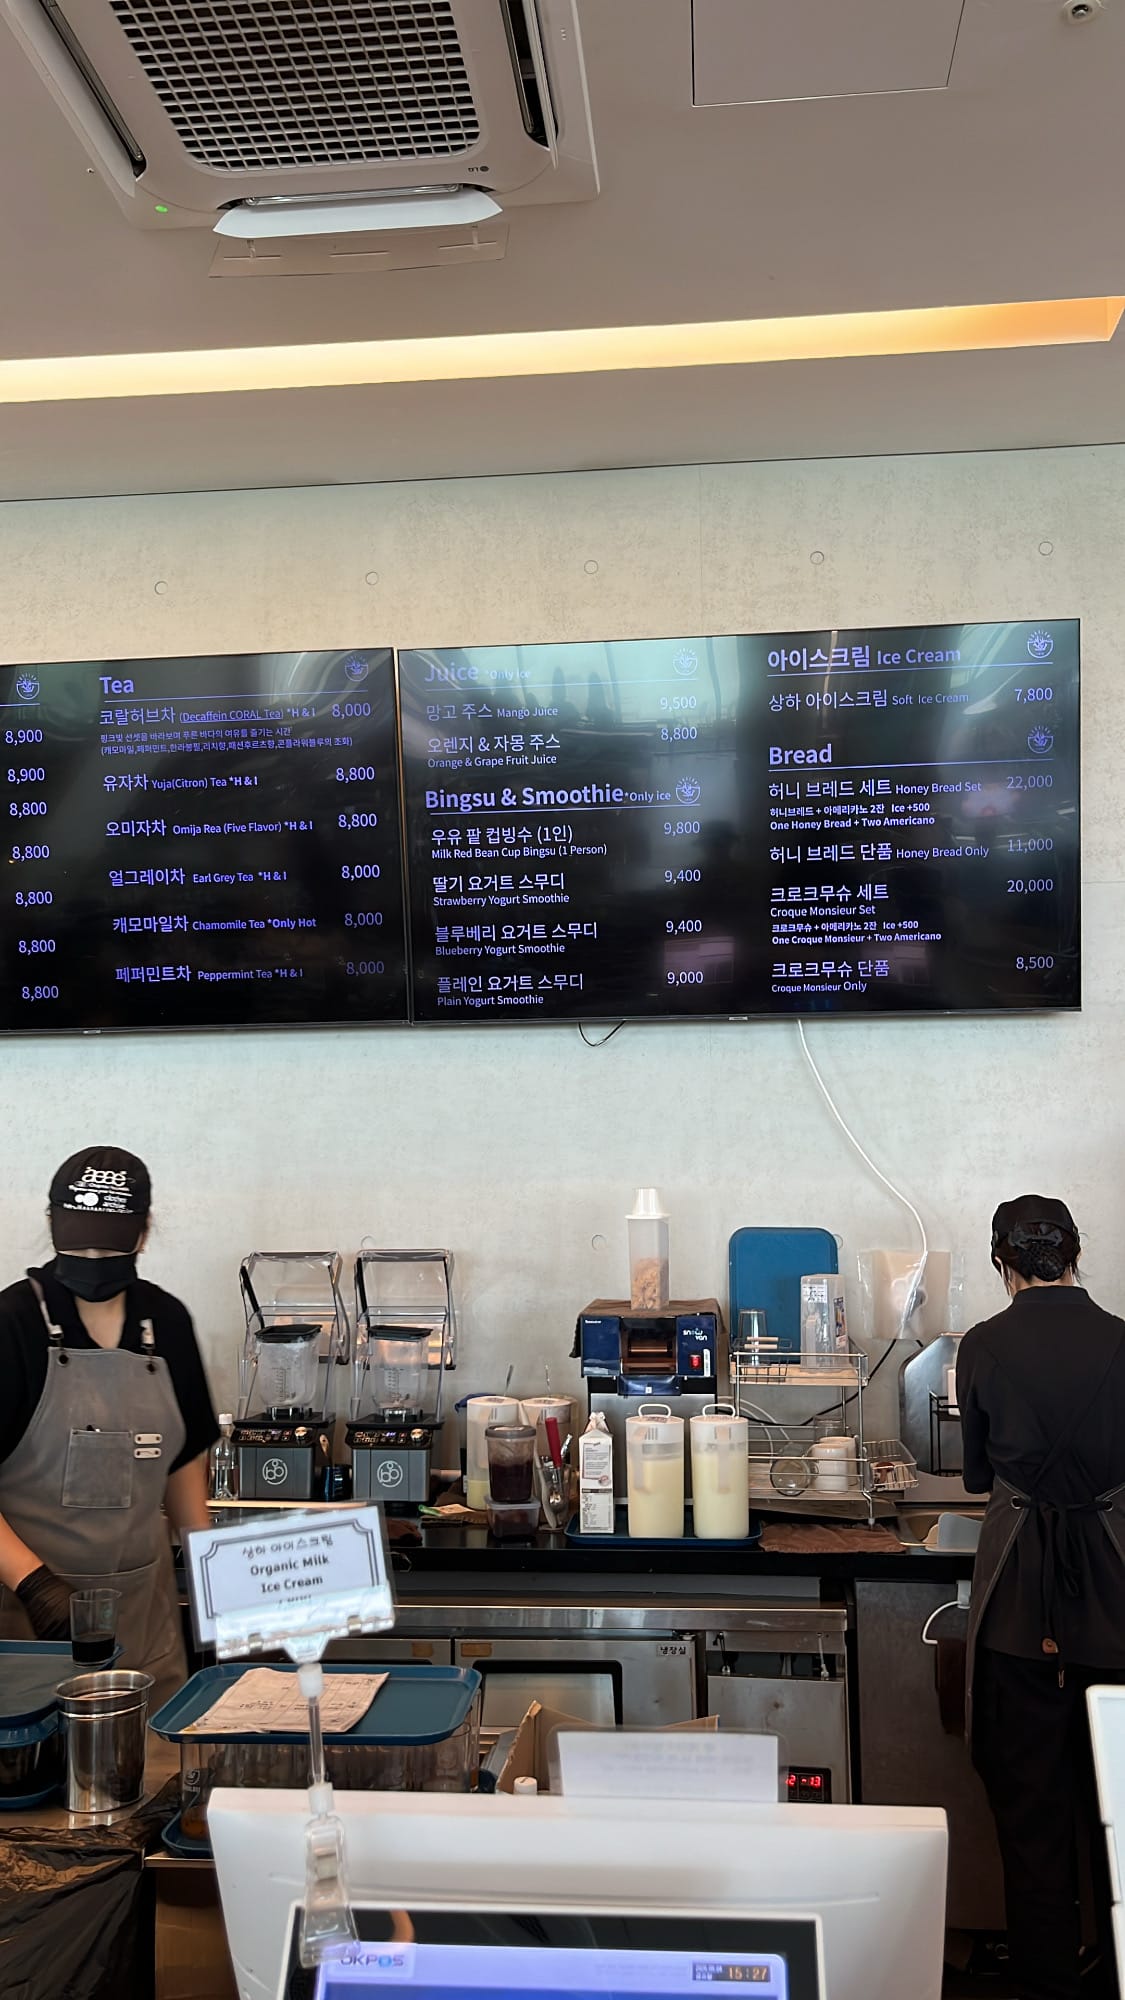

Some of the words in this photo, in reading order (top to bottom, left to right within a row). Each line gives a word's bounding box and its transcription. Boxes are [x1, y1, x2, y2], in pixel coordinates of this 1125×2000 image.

[768, 645, 870, 670] 아이스크림
[877, 650, 901, 665] Ice
[905, 649, 961, 664] Cream
[424, 662, 478, 682] Juice
[99, 676, 134, 694] Tea
[660, 696, 697, 711] 9,500
[769, 694, 800, 712] 상하
[806, 690, 888, 709] 아이스크림
[892, 695, 913, 706] Soft
[918, 694, 933, 704] Ice
[935, 692, 969, 704] Cream
[1014, 688, 1053, 704] 7,800
[99, 707, 176, 726] 코랄허브차
[180, 710, 227, 723] (Decaffein
[230, 711, 261, 720] CORAL
[264, 709, 283, 719] Tea)
[332, 702, 371, 720] 8,000
[426, 704, 456, 721] 망고
[462, 703, 493, 720] 주스
[497, 708, 530, 719] Mango
[532, 706, 558, 717] Juice
[5, 729, 43, 746] 8,900
[428, 736, 473, 753] 오렌지
[479, 737, 490, 752] &
[494, 734, 525, 752] 자몽
[529, 734, 560, 750] 주스
[660, 727, 698, 743] 8,800
[428, 758, 462, 770] Orange
[474, 756, 503, 768] Grape
[506, 755, 528, 766] Fruit
[531, 754, 557, 765] Juice
[769, 744, 833, 766] Bread
[7, 768, 45, 784] 8,900
[103, 774, 148, 792] 유자차
[152, 779, 208, 790] Yuja(Citron)
[210, 777, 227, 787] Tea
[336, 767, 374, 784] 8,800
[1006, 775, 1053, 791] 22,000
[425, 789, 496, 812] Bingsu
[501, 788, 516, 806] &
[522, 784, 624, 806] Smoothie
[769, 782, 800, 800] 허니
[806, 781, 854, 798] 브레드
[859, 779, 892, 797] 세트
[896, 783, 928, 796] Honey
[931, 781, 962, 793] Bread
[964, 781, 982, 792] Set
[9, 802, 47, 818] 8,800
[770, 807, 814, 817] 허니브레드
[892, 804, 905, 812] Ice
[907, 803, 930, 811] +500
[105, 819, 167, 836] 오미자차
[173, 825, 201, 836] Omija
[204, 824, 221, 833] Rea
[224, 823, 246, 835] (Five
[249, 822, 281, 833] Flavor)
[338, 813, 377, 831] 8,800
[664, 821, 700, 836] 9,800
[770, 822, 789, 830] One
[792, 821, 821, 831] Honey
[824, 819, 851, 828] Bread
[862, 818, 881, 827] Two
[883, 816, 935, 826] Americano
[432, 829, 462, 845] 우유
[486, 827, 532, 844] 컵빙수
[537, 826, 573, 844] (1인)
[12, 845, 50, 862] 8,800
[432, 849, 451, 859] Milk
[454, 848, 472, 858] Red
[475, 848, 499, 857] Bean
[502, 847, 520, 859] Cup
[524, 846, 556, 859] Bingsu
[559, 846, 567, 856] (1
[570, 844, 607, 856] Person)
[770, 845, 800, 864] 허니
[806, 845, 855, 862] 브레드
[860, 843, 893, 860] 단품
[896, 848, 929, 860] Honey
[932, 847, 962, 858] Bread
[965, 845, 989, 858] Only
[1008, 839, 1053, 854] 11,000
[109, 868, 185, 887] 얼그레이차
[193, 873, 212, 883] Earl
[213, 874, 235, 884] Grey
[237, 873, 253, 882] Tea
[341, 864, 380, 881] 8,000
[664, 870, 700, 885] 9,400
[433, 876, 462, 892] 딸기
[468, 874, 514, 892] 요거트
[519, 873, 565, 890] 스무디
[1007, 879, 1053, 894] 20,000
[15, 891, 53, 907] 8,800
[433, 895, 486, 907] Strawberry
[489, 895, 520, 907] Yogurt
[522, 893, 569, 904] Smoothie
[770, 886, 852, 903] 크로크무슈
[856, 884, 889, 900] 세트
[770, 907, 807, 918] Croque
[810, 905, 856, 916] Monsieur
[859, 904, 876, 915] Set
[113, 915, 189, 934] 캐모마일차
[192, 920, 247, 930] Chamomile
[249, 920, 265, 929] Tea
[298, 918, 316, 927] Hot
[344, 912, 383, 929] 8,000
[666, 920, 702, 935] 9,400
[897, 921, 918, 929] +500
[435, 925, 496, 942] 블루베리
[501, 924, 547, 940] 요거트
[552, 922, 598, 939] 스무디
[772, 936, 789, 944] One
[792, 936, 822, 945] Croque
[825, 934, 865, 943] Monsieur
[894, 932, 941, 941] Americano
[19, 939, 55, 955] 8,800
[436, 946, 482, 957] Blueberry
[484, 945, 516, 956] Yogurt
[518, 943, 565, 954] Smoothie
[346, 961, 384, 978] 8,000
[772, 961, 853, 979] 크로크무슈
[858, 960, 889, 978] 단품
[1016, 956, 1053, 973] 8,500
[115, 965, 191, 983] 페퍼민트차
[198, 970, 254, 982] Peppermint
[256, 970, 272, 978] Tea
[667, 971, 703, 986] 9,000
[437, 976, 482, 993] 플레인
[488, 975, 533, 992] 요거트
[538, 974, 584, 990] 스무디
[771, 983, 801, 993] Croque
[804, 982, 841, 993] Monsieur
[843, 981, 867, 992] Only
[22, 986, 59, 1002] 8,800
[438, 996, 461, 1006] Plain
[464, 996, 495, 1007] Yogurt
[497, 994, 544, 1004] Smoothie
[250, 1558, 299, 1576] Organic
[303, 1554, 328, 1567] Milk
[261, 1582, 280, 1593] Ice
[284, 1576, 323, 1590] Cream
[660, 1646, 686, 1655] 냉장실
[729, 1967, 767, 1980] 15:27
